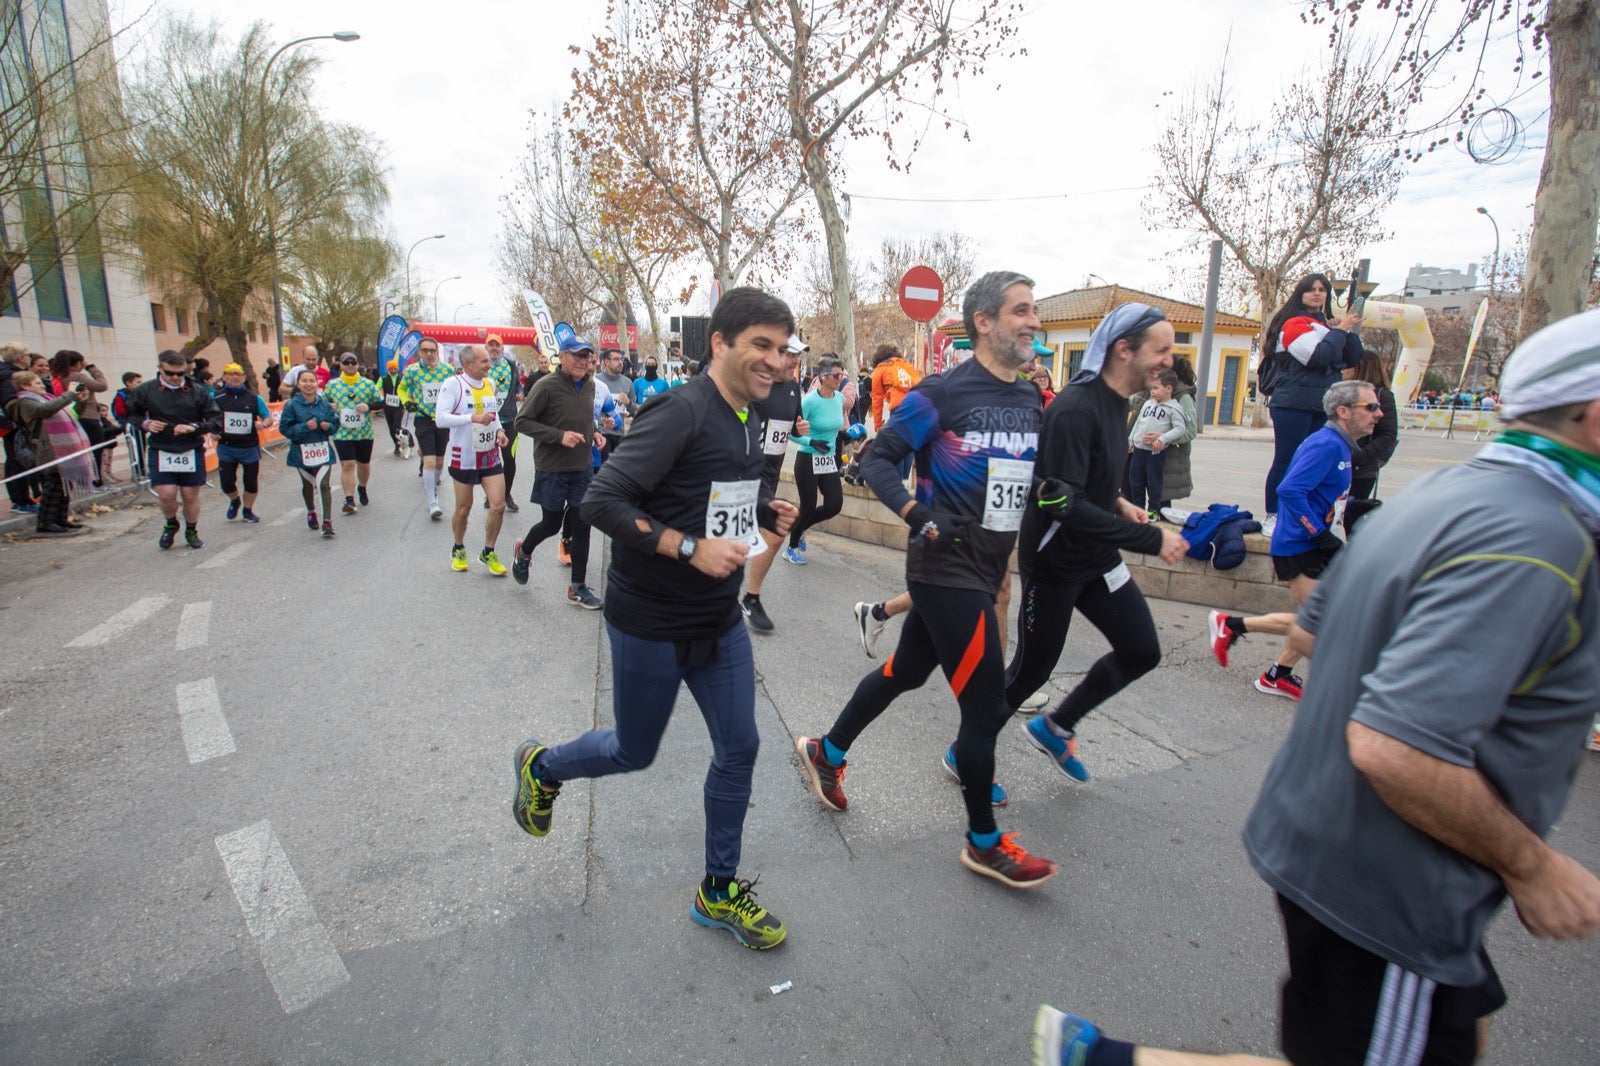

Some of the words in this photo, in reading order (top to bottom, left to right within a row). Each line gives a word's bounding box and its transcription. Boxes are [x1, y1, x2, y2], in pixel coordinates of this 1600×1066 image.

[344, 414, 361, 423] 202
[1142, 406, 1166, 420] GAP
[229, 418, 248, 427] 203
[968, 406, 1034, 433] SNOW
[304, 448, 328, 459] 2066
[165, 455, 190, 465] 148
[711, 506, 755, 537] 3164
